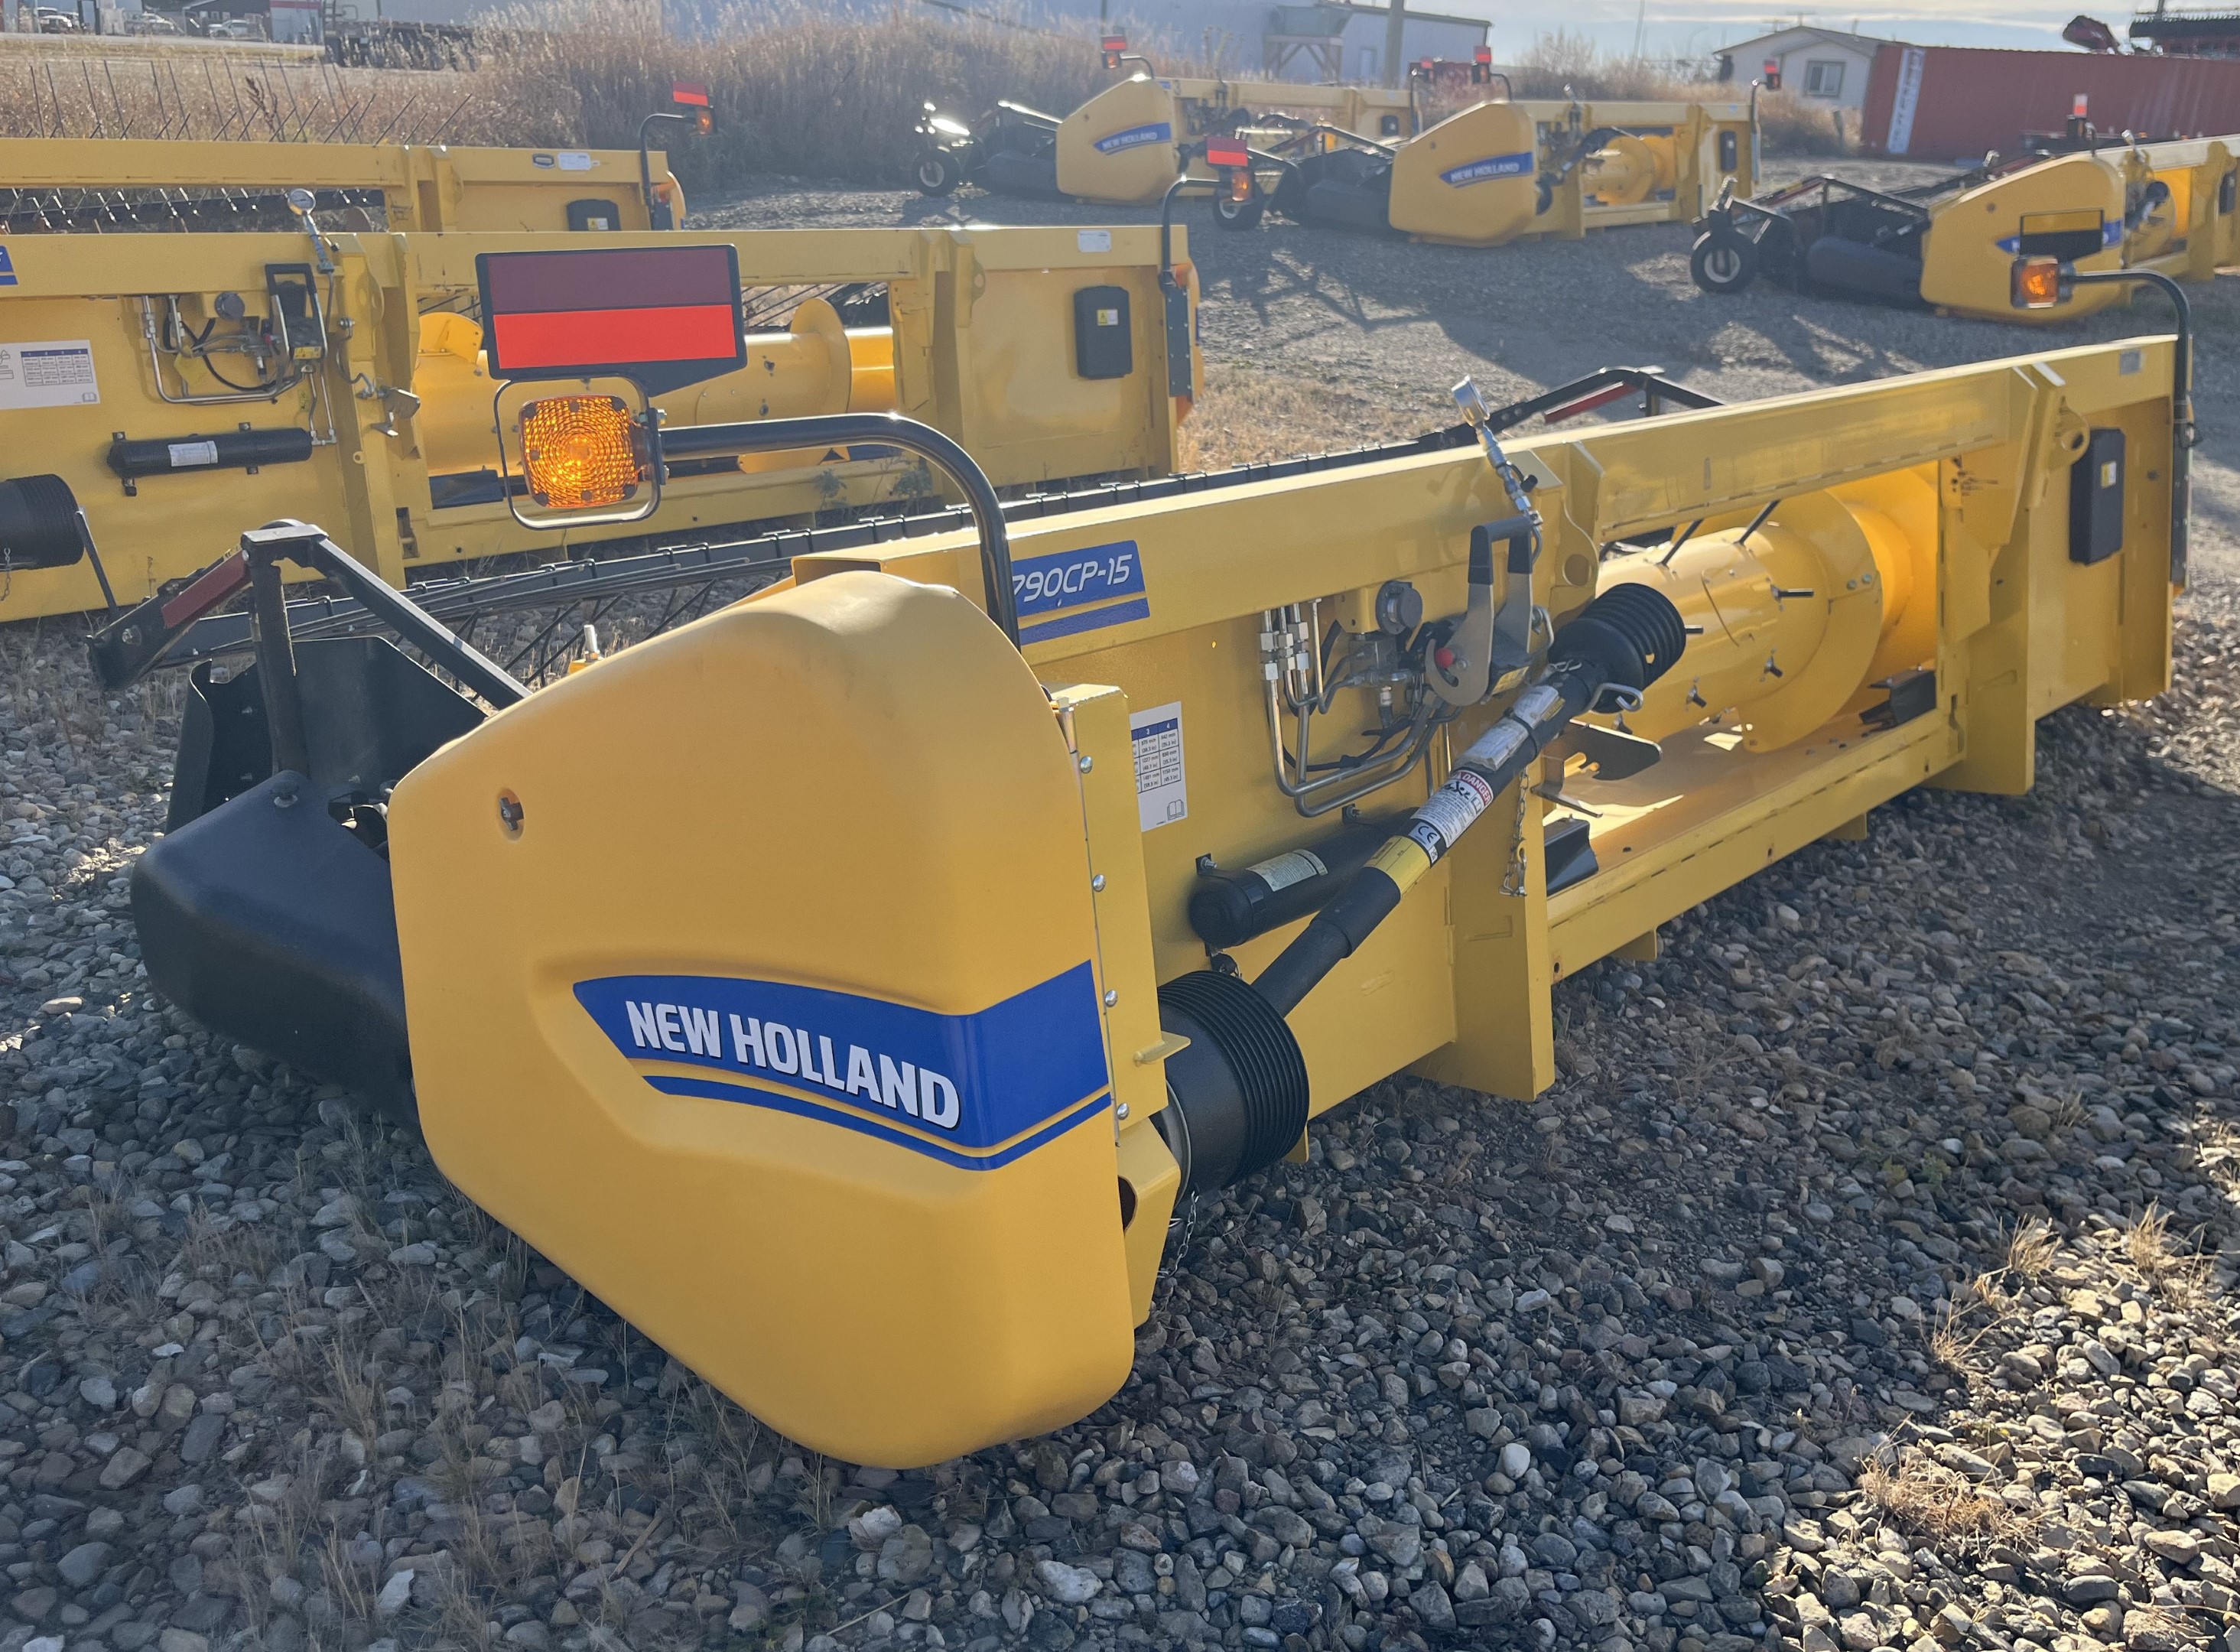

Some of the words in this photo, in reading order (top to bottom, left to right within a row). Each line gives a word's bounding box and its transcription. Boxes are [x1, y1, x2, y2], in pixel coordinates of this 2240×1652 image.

[1451, 169, 1473, 182] NEW
[1474, 162, 1520, 176] HOLLAND
[1013, 554, 1133, 602] 790CP-15
[1461, 773, 1491, 805] DANGER
[625, 1000, 722, 1058] NEW
[729, 1013, 961, 1129] HOLLAND
